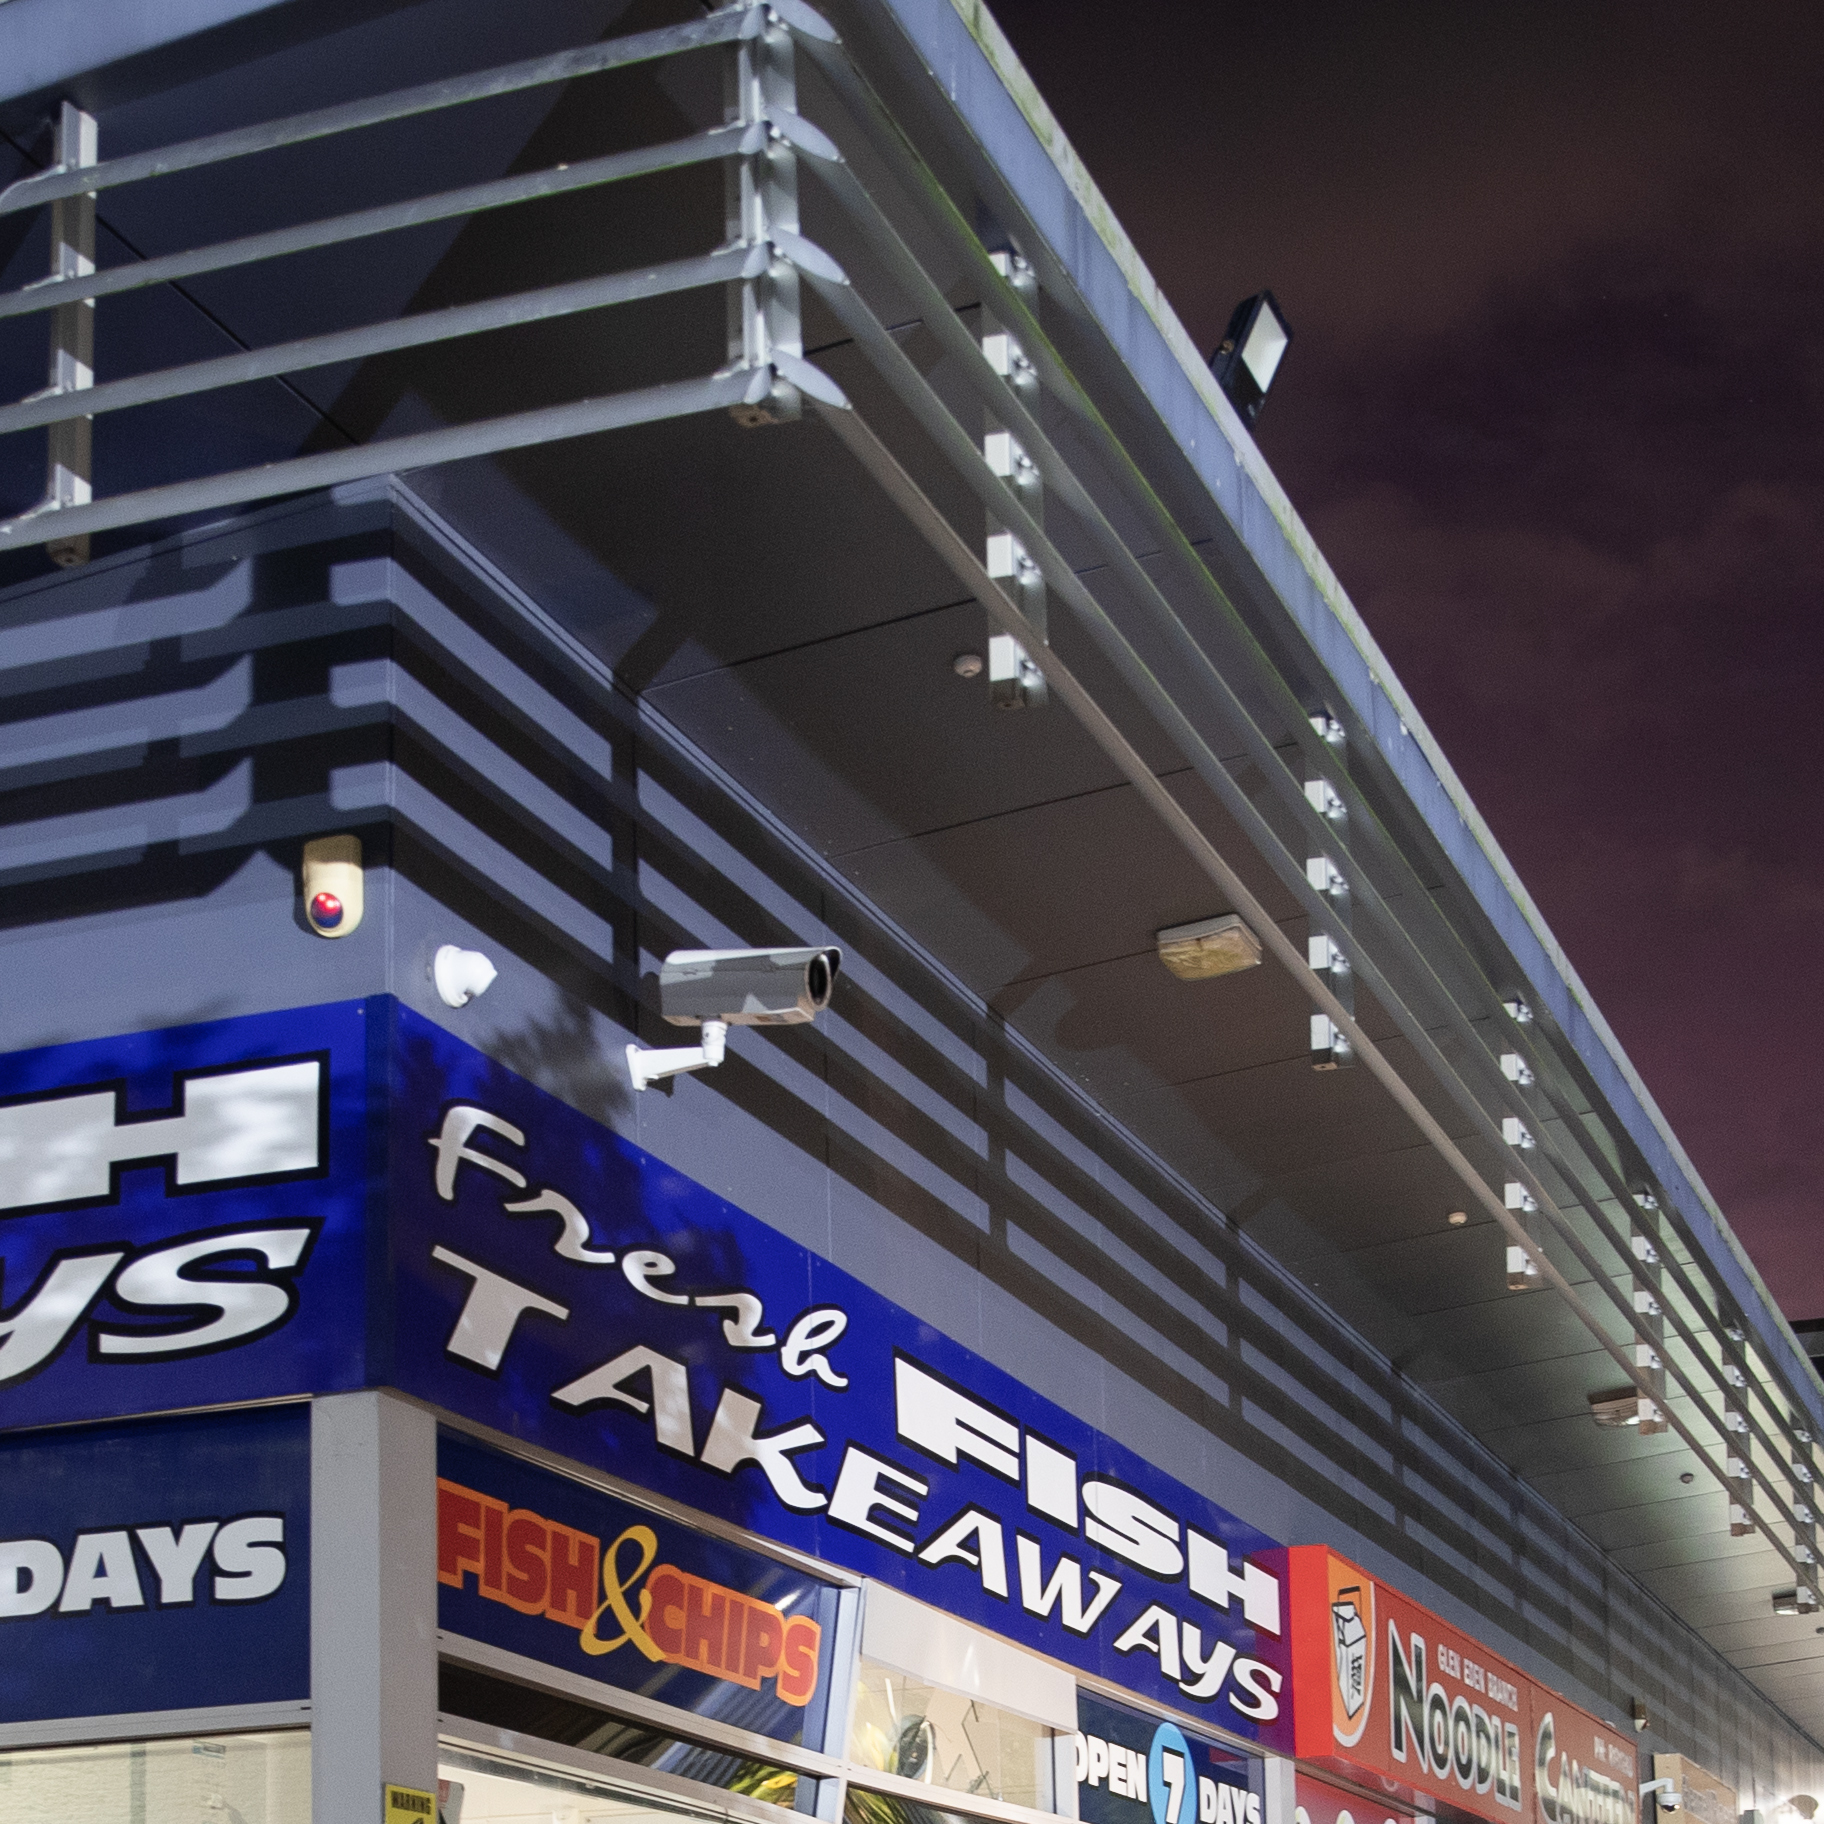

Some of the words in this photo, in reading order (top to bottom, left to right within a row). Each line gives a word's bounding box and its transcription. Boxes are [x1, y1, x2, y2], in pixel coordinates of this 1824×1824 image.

[429, 1106, 848, 1388] Fresh
[894, 1357, 1281, 1635] FISH
[1388, 1618, 1522, 1812] NOODLE
